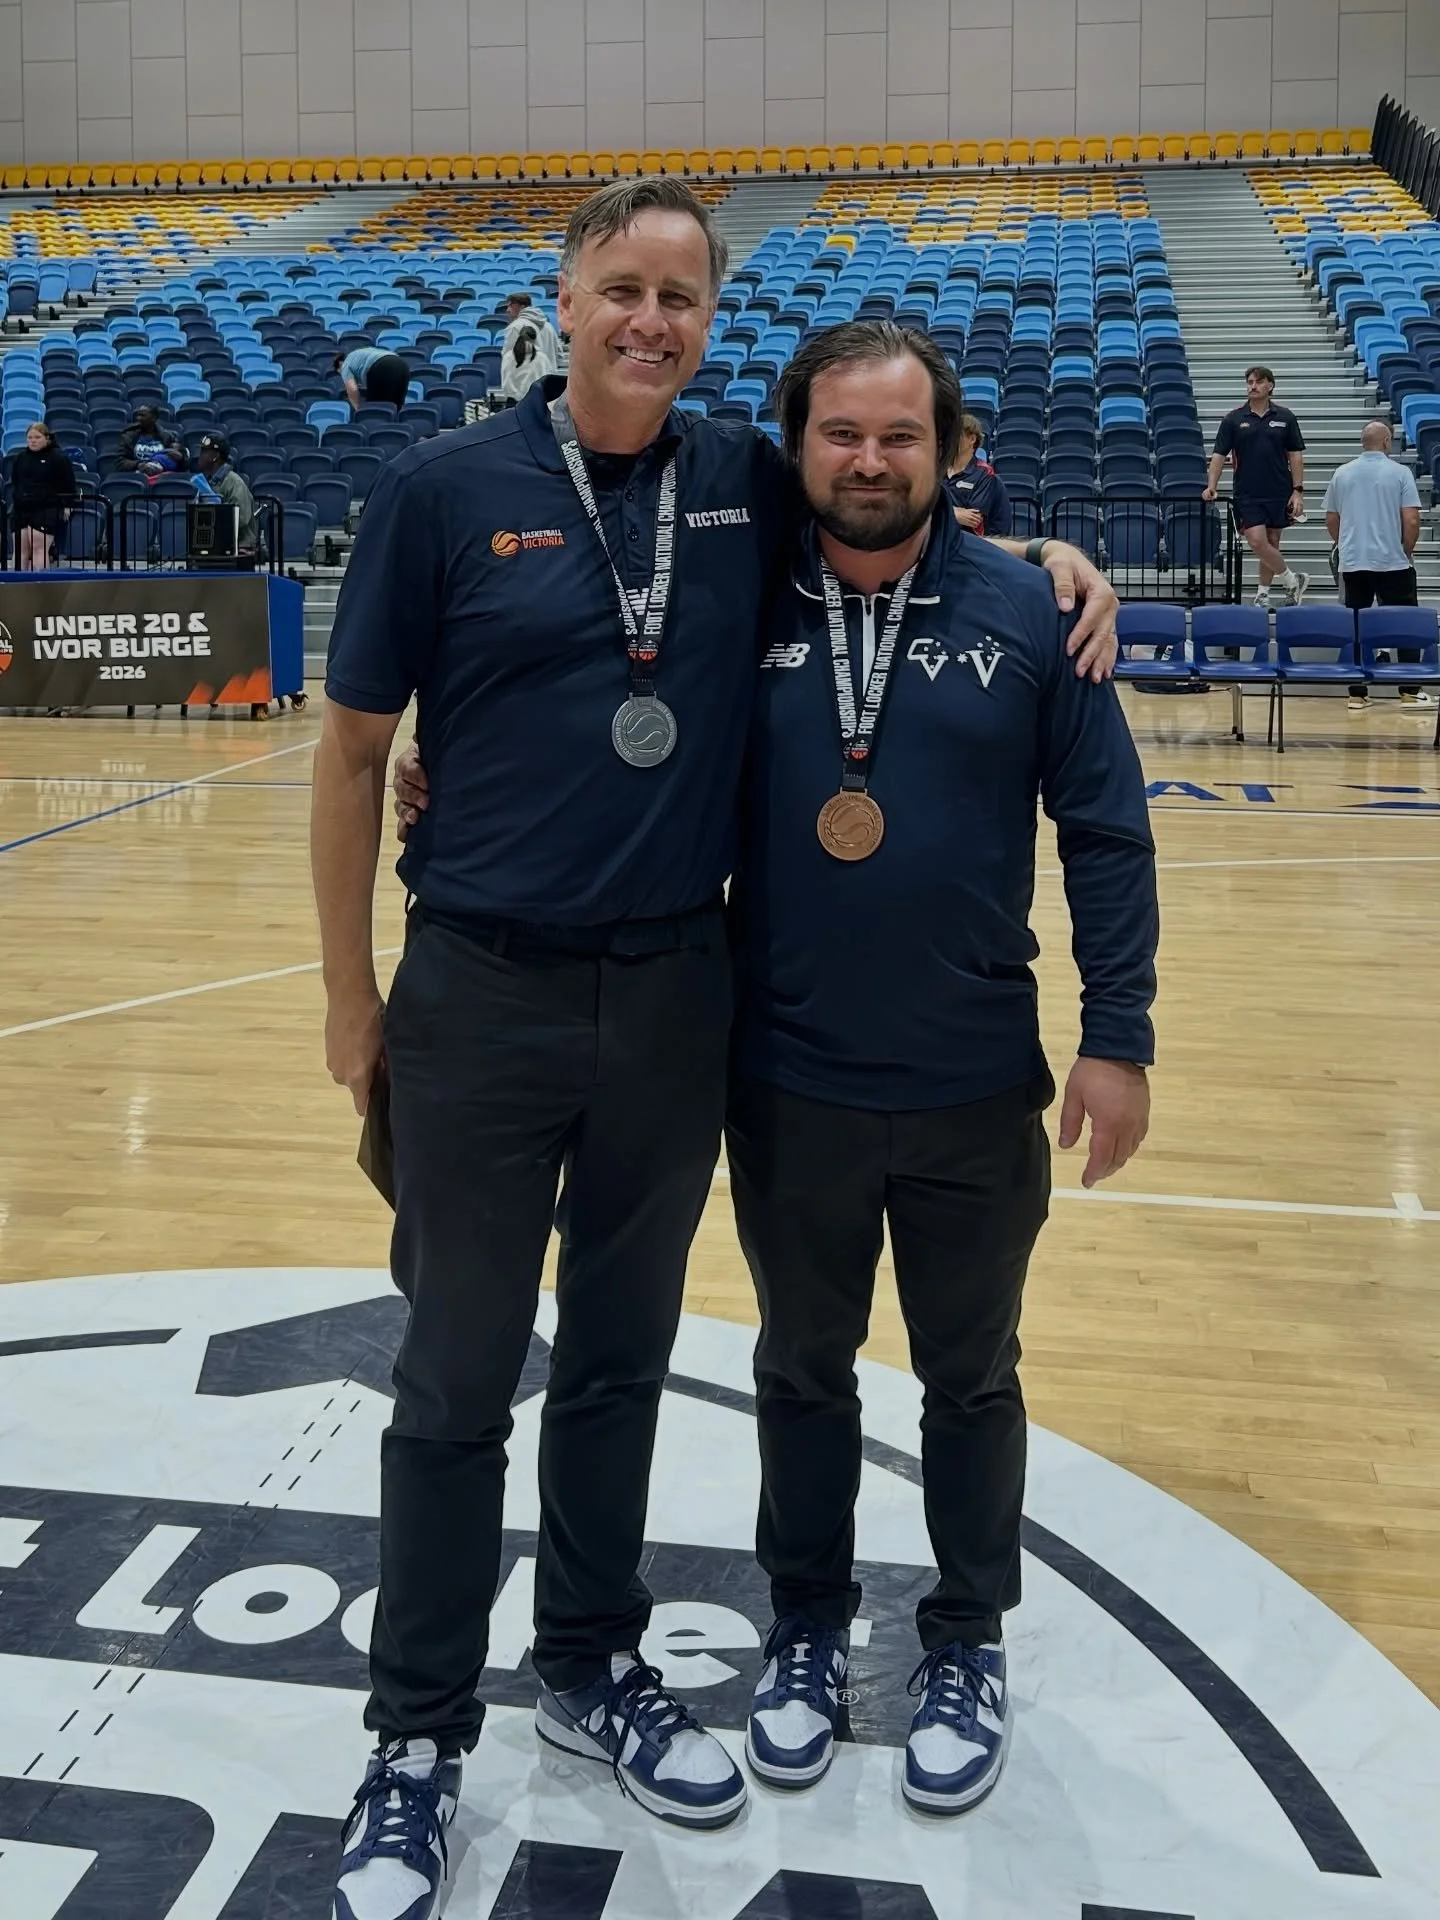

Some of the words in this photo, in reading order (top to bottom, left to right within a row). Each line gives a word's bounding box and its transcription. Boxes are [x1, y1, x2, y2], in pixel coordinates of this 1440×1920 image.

[561, 439, 598, 519] CHAMPIONSHIPS
[685, 507, 751, 528] VICTORIA
[521, 528, 563, 539] BASKETBALL
[522, 536, 565, 549] VICTORIA
[654, 523, 674, 571] NATIONAL
[648, 572, 671, 609] LOCKER
[822, 573, 843, 608] LOCKER
[34, 614, 137, 636] UNDER
[143, 612, 180, 634] 20
[187, 612, 209, 633] &
[643, 611, 665, 635] FOOT
[826, 609, 849, 658] NATIONAL
[33, 638, 103, 660] IVOR
[109, 635, 211, 658] BURGE
[873, 623, 901, 670] NATIONAL
[99, 665, 147, 680] 2026
[832, 658, 857, 739] CHAMPIONSHIPS
[864, 672, 888, 709] LOCKER
[857, 709, 878, 735] FOOT
